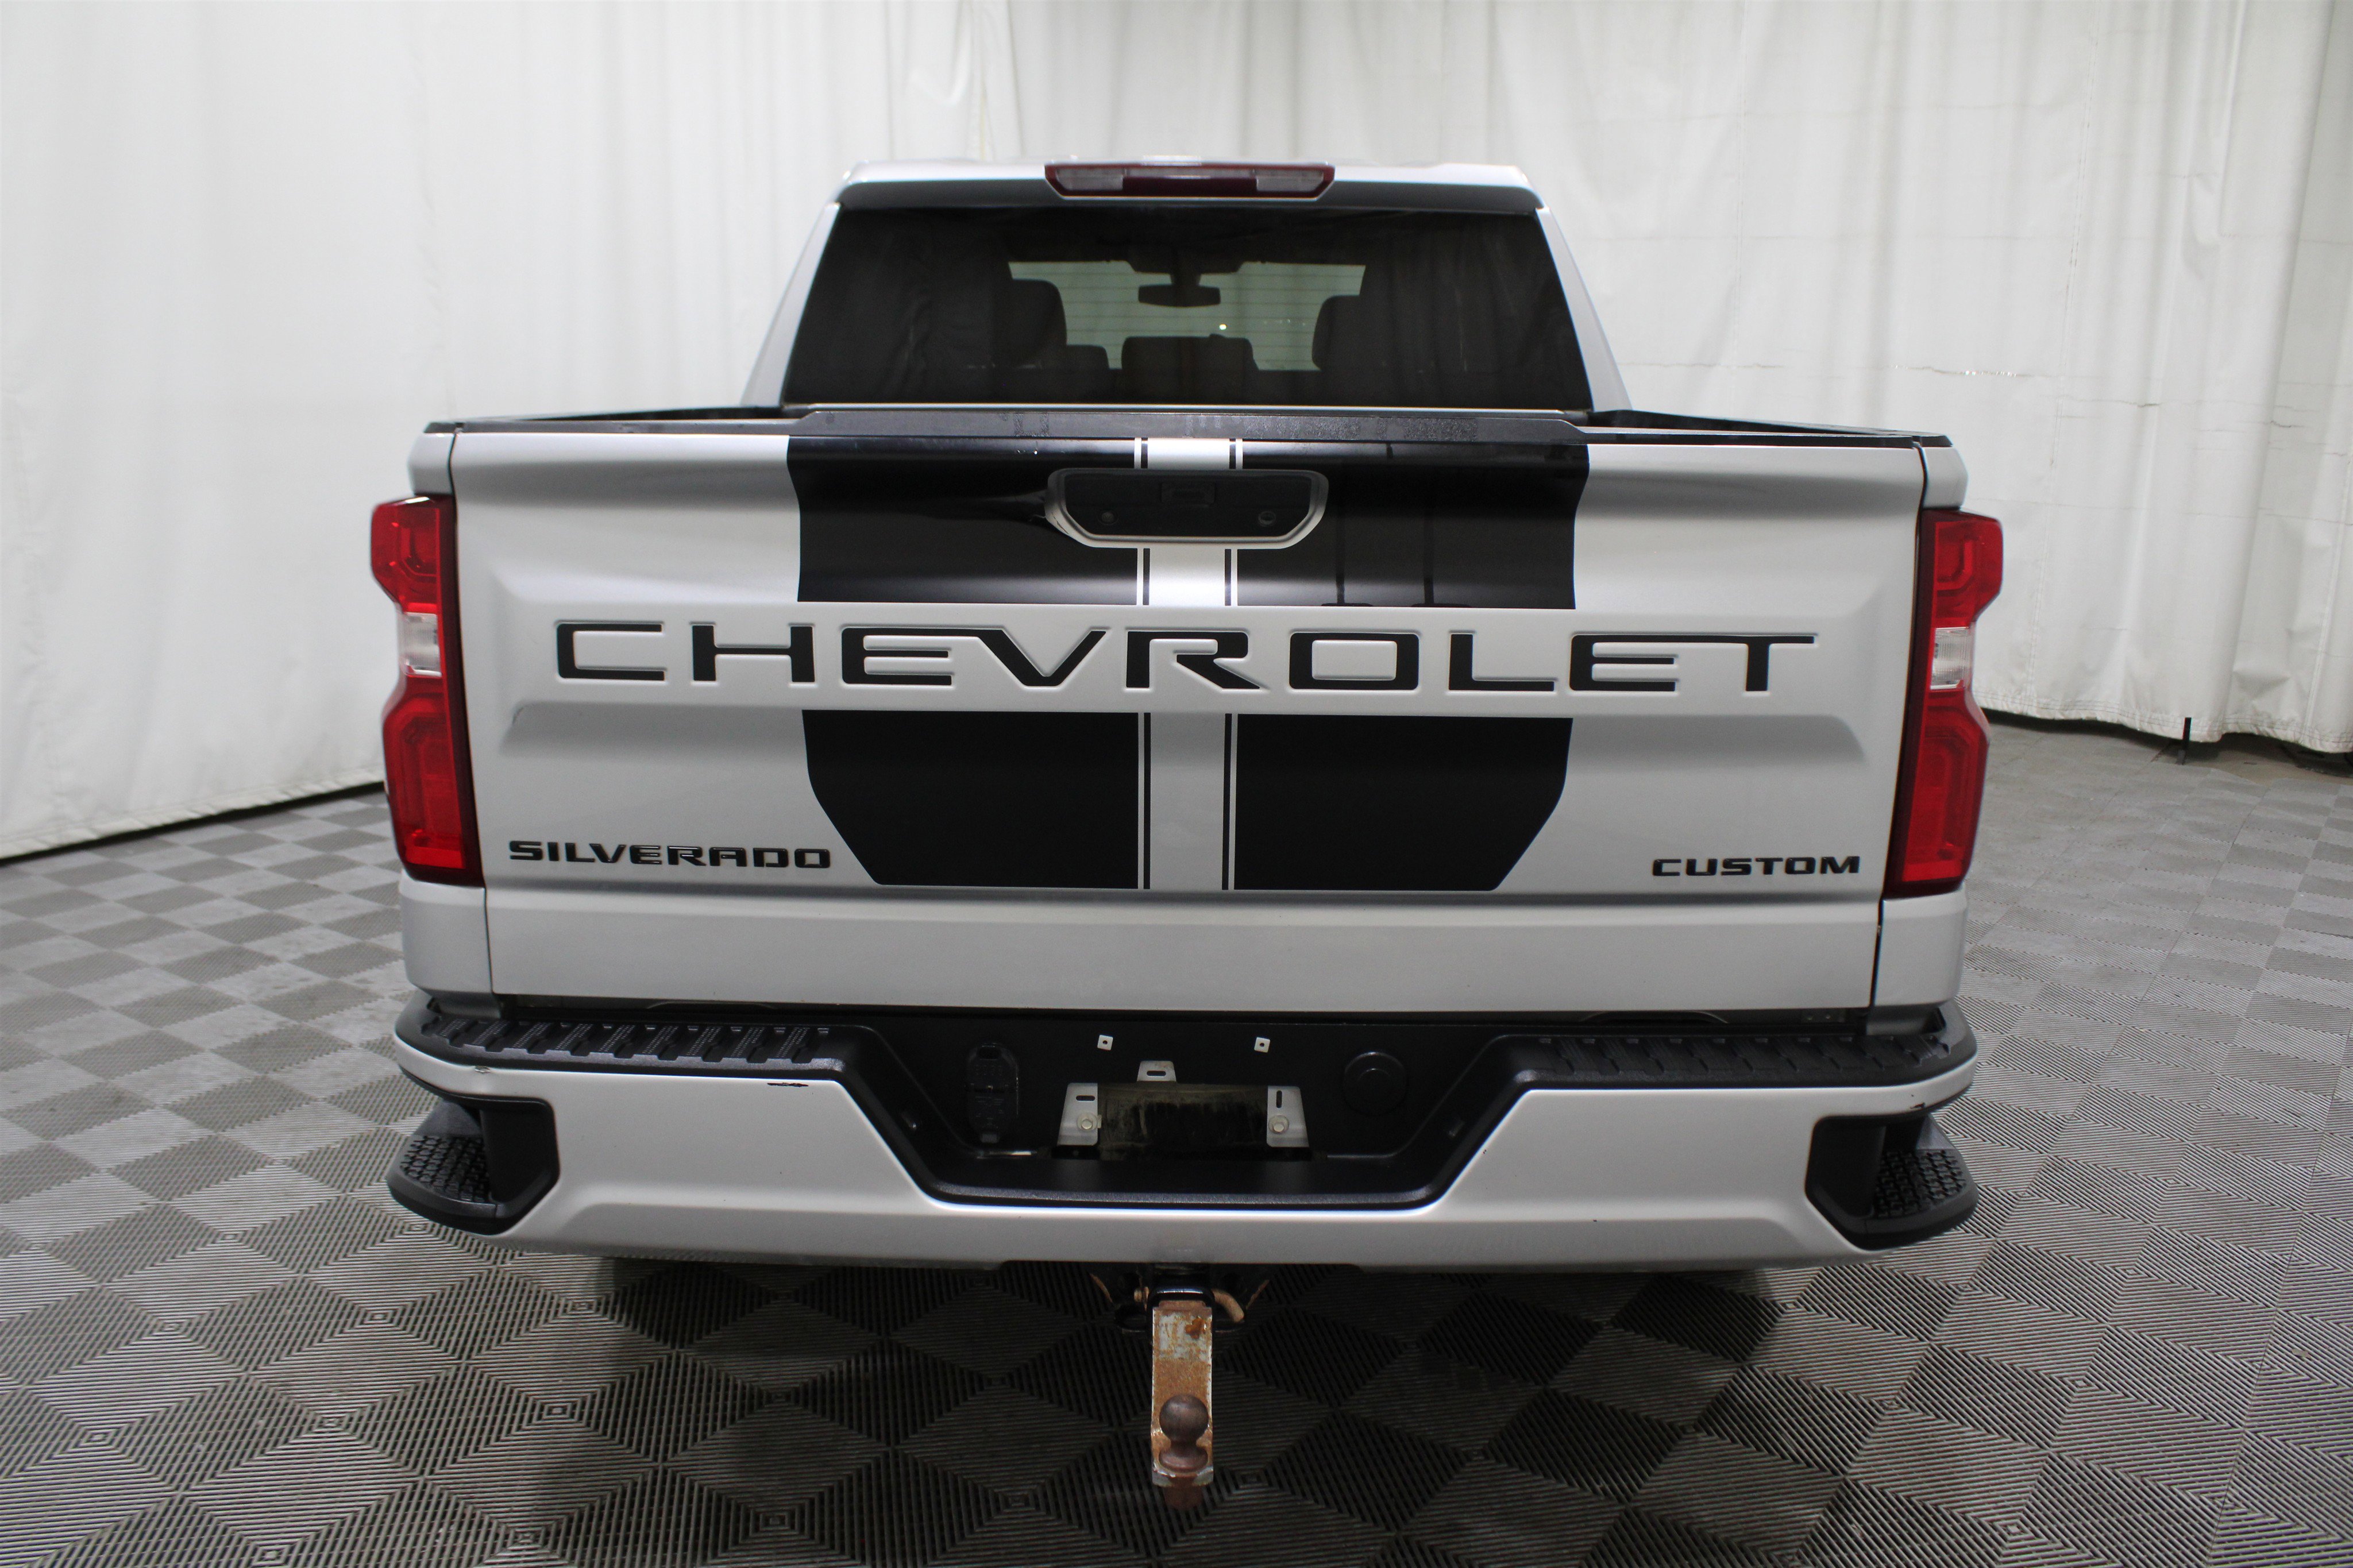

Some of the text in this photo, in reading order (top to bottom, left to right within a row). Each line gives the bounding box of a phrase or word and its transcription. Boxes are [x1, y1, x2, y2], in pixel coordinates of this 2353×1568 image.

[556, 623, 1815, 693] CHEVROLET
[509, 840, 831, 869] SILVERADO
[1652, 856, 1861, 877] CUSTOM
